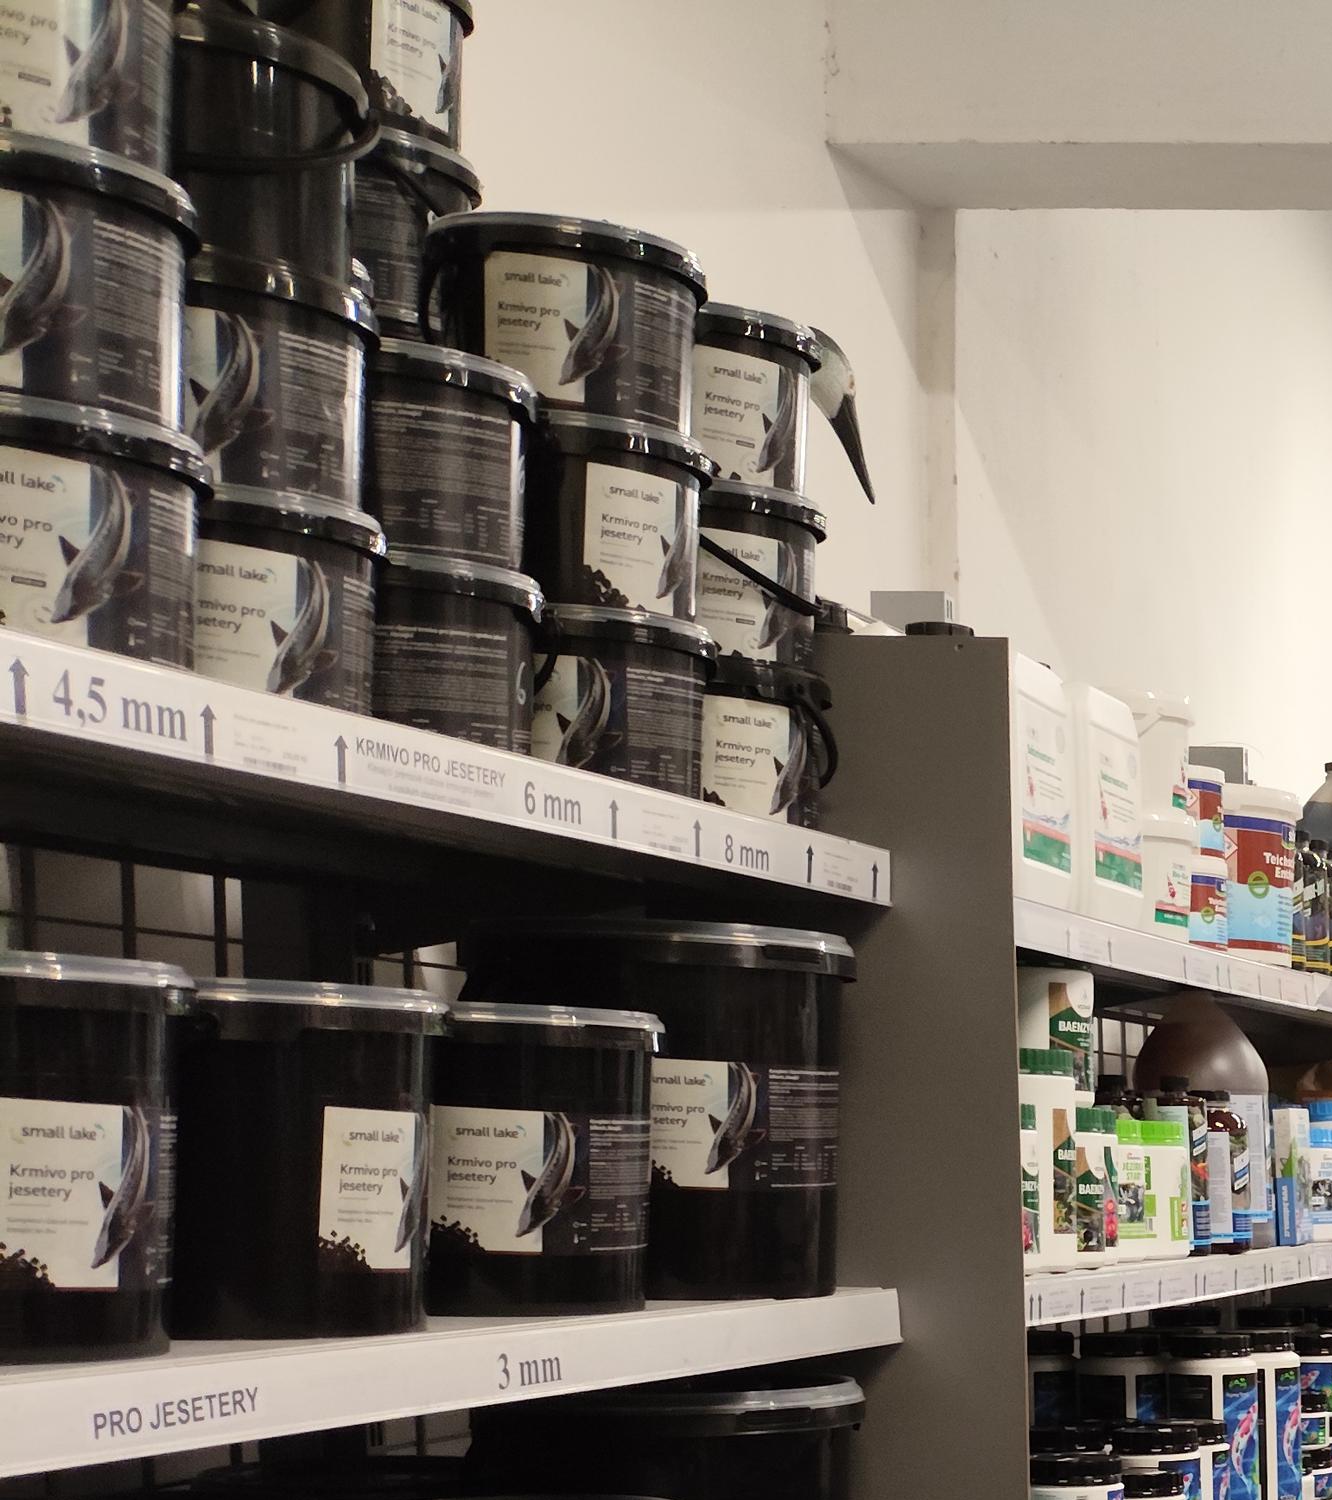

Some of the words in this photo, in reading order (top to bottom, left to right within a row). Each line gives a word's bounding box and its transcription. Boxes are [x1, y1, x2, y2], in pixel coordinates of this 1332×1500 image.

[21, 472, 57, 493] lake
[609, 484, 638, 499] small
[640, 489, 660, 505] lake
[24, 518, 53, 537] pro
[601, 512, 640, 531] Krmivo
[642, 520, 659, 536] pro
[600, 528, 643, 546] jesetery
[239, 565, 269, 583] lake
[241, 604, 266, 622] pro
[53, 669, 107, 729] 4,5
[122, 695, 188, 742] mm
[356, 737, 410, 766] KRMIVO
[414, 752, 441, 775] PRO
[444, 760, 506, 786] JESETERY
[524, 781, 536, 815] 6
[543, 793, 581, 825] mm
[725, 834, 734, 863] 8
[740, 845, 769, 872] mm
[679, 1074, 706, 1087] lake
[687, 1105, 705, 1117] pro
[21, 1124, 62, 1140] small
[64, 1125, 97, 1142] lake
[349, 1130, 377, 1143] small
[379, 1130, 400, 1144] lake
[455, 1126, 489, 1139] small
[492, 1126, 519, 1140] lake
[340, 1163, 379, 1177] Krmivo
[381, 1166, 398, 1181] pro
[448, 1155, 493, 1170] Krmivo
[495, 1159, 517, 1174] pro
[9, 1164, 67, 1182] Krmivo
[71, 1168, 95, 1187] pro
[447, 1169, 497, 1186] jesetery
[9, 1181, 72, 1202] jesetery
[339, 1179, 383, 1197] jesetery
[498, 1353, 511, 1390] 3
[519, 1353, 563, 1387] mm
[94, 1406, 142, 1440] PRO
[149, 1387, 259, 1432] JESETERY
